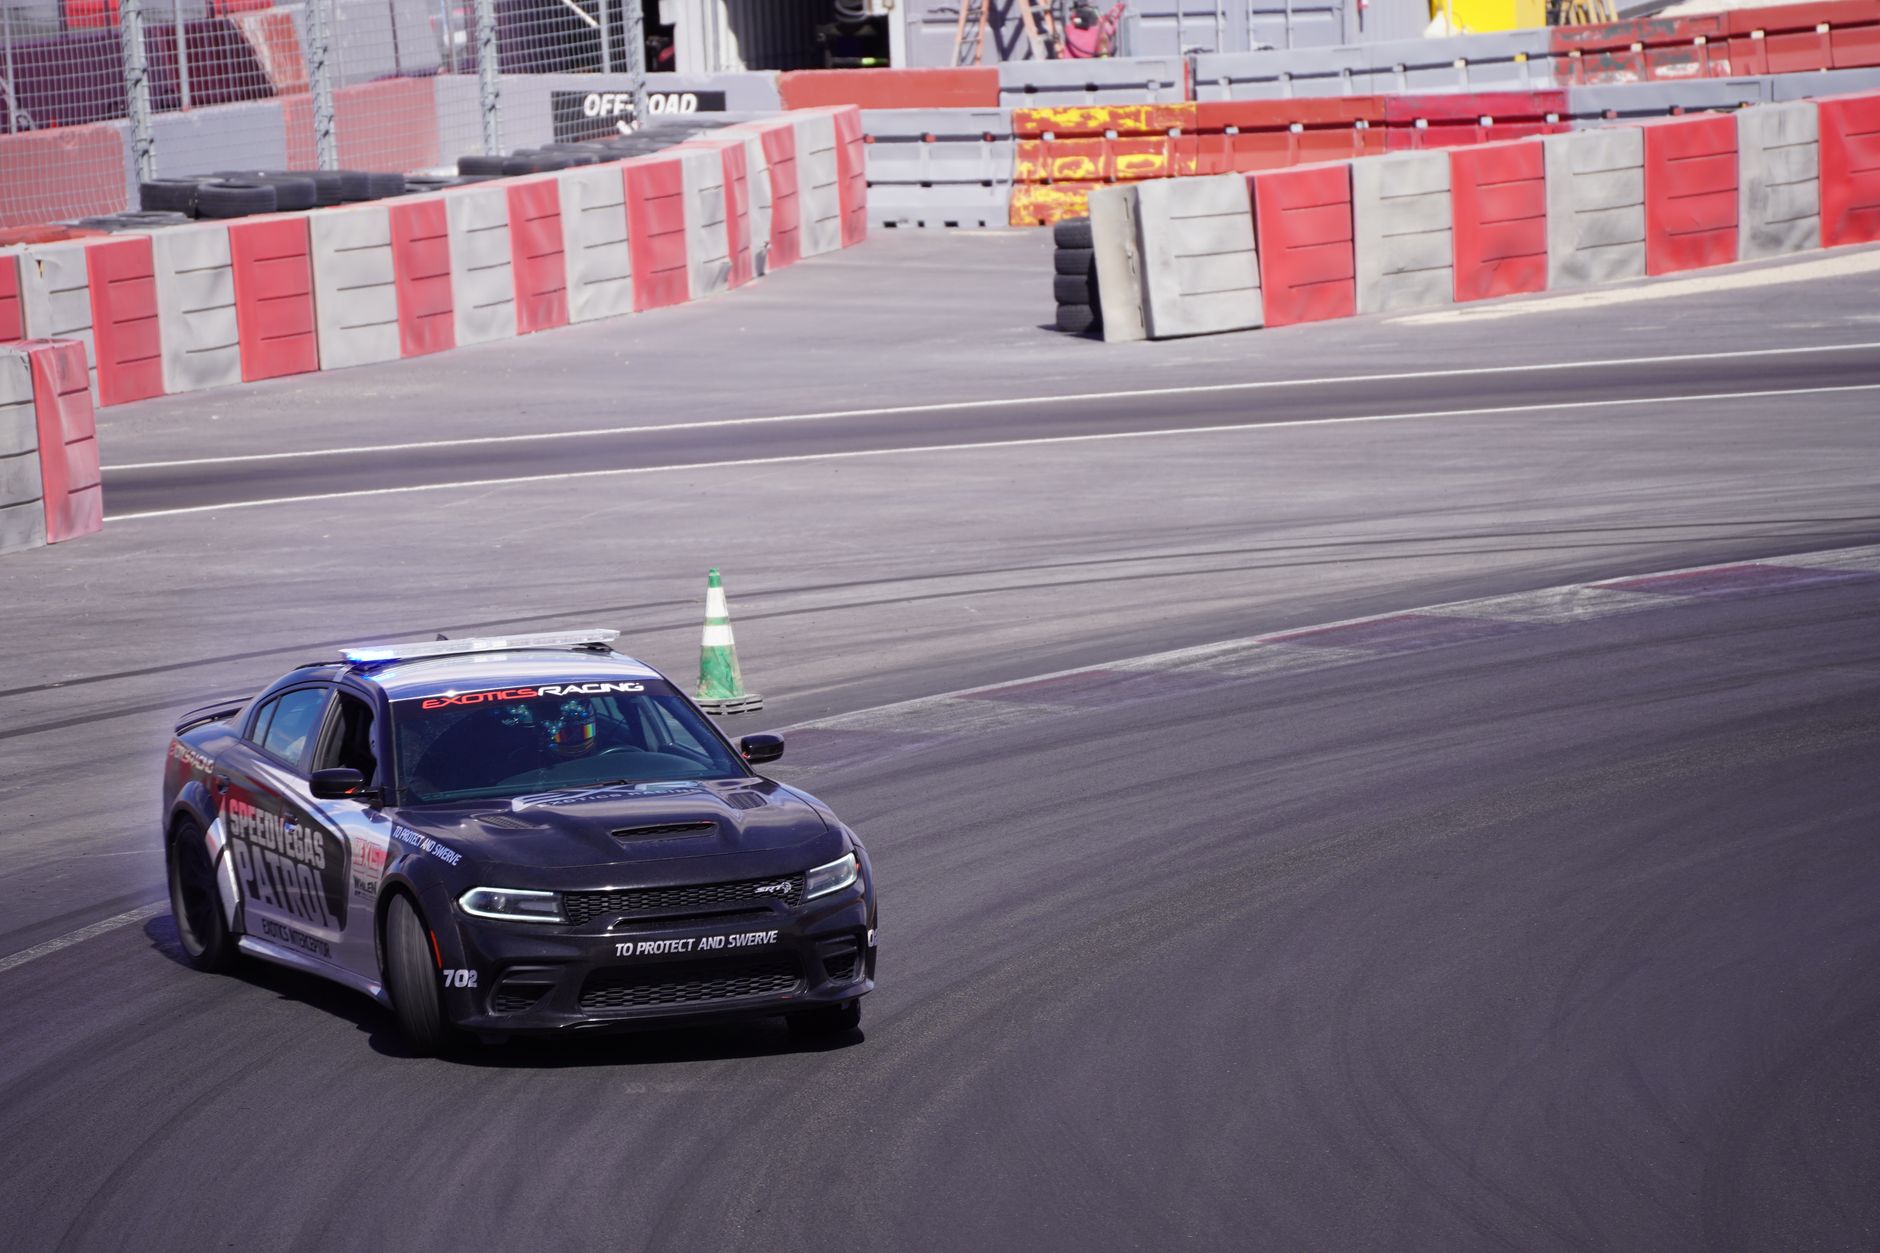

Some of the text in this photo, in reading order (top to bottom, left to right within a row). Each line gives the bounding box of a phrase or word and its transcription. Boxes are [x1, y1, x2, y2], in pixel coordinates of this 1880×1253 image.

[584, 92, 698, 117] OFF-OAD
[229, 799, 326, 869] SPEEDVEGAS
[432, 844, 463, 867] SWERVE
[231, 837, 341, 931] PATROL
[615, 929, 779, 957] TO PROTECT AND SWERVE
[443, 969, 478, 988] 702
